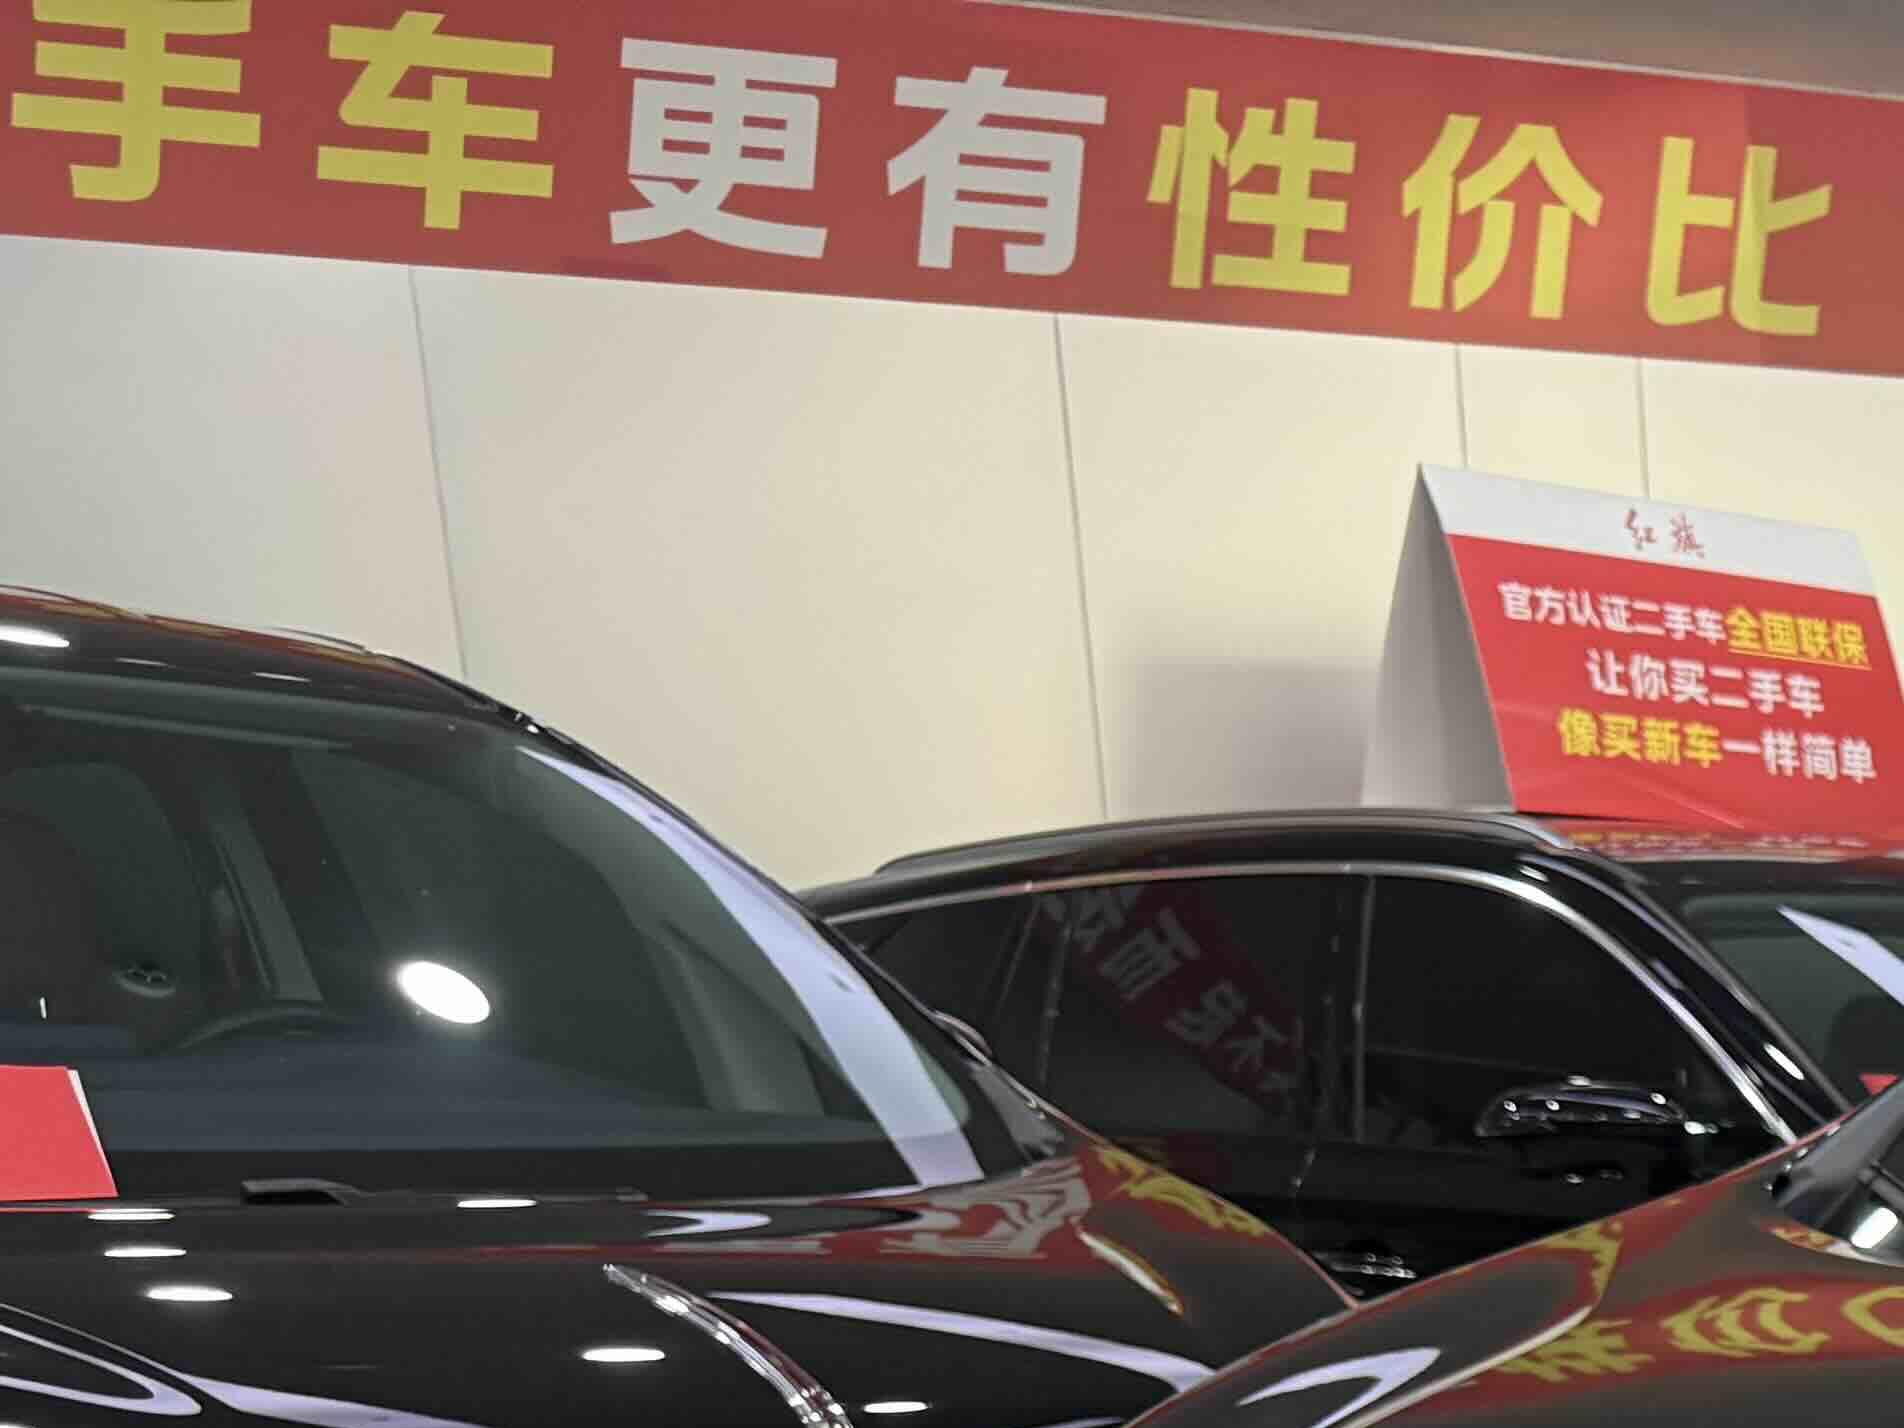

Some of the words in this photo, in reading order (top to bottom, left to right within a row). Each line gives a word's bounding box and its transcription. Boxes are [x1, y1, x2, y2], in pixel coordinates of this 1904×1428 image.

[10, 0, 1833, 336] 手车更有性价比
[1497, 580, 1870, 664] 官方认证二手车全国联保
[1585, 648, 1826, 719] 让你买二手车
[1558, 707, 1877, 784] 像买新车一样简单
